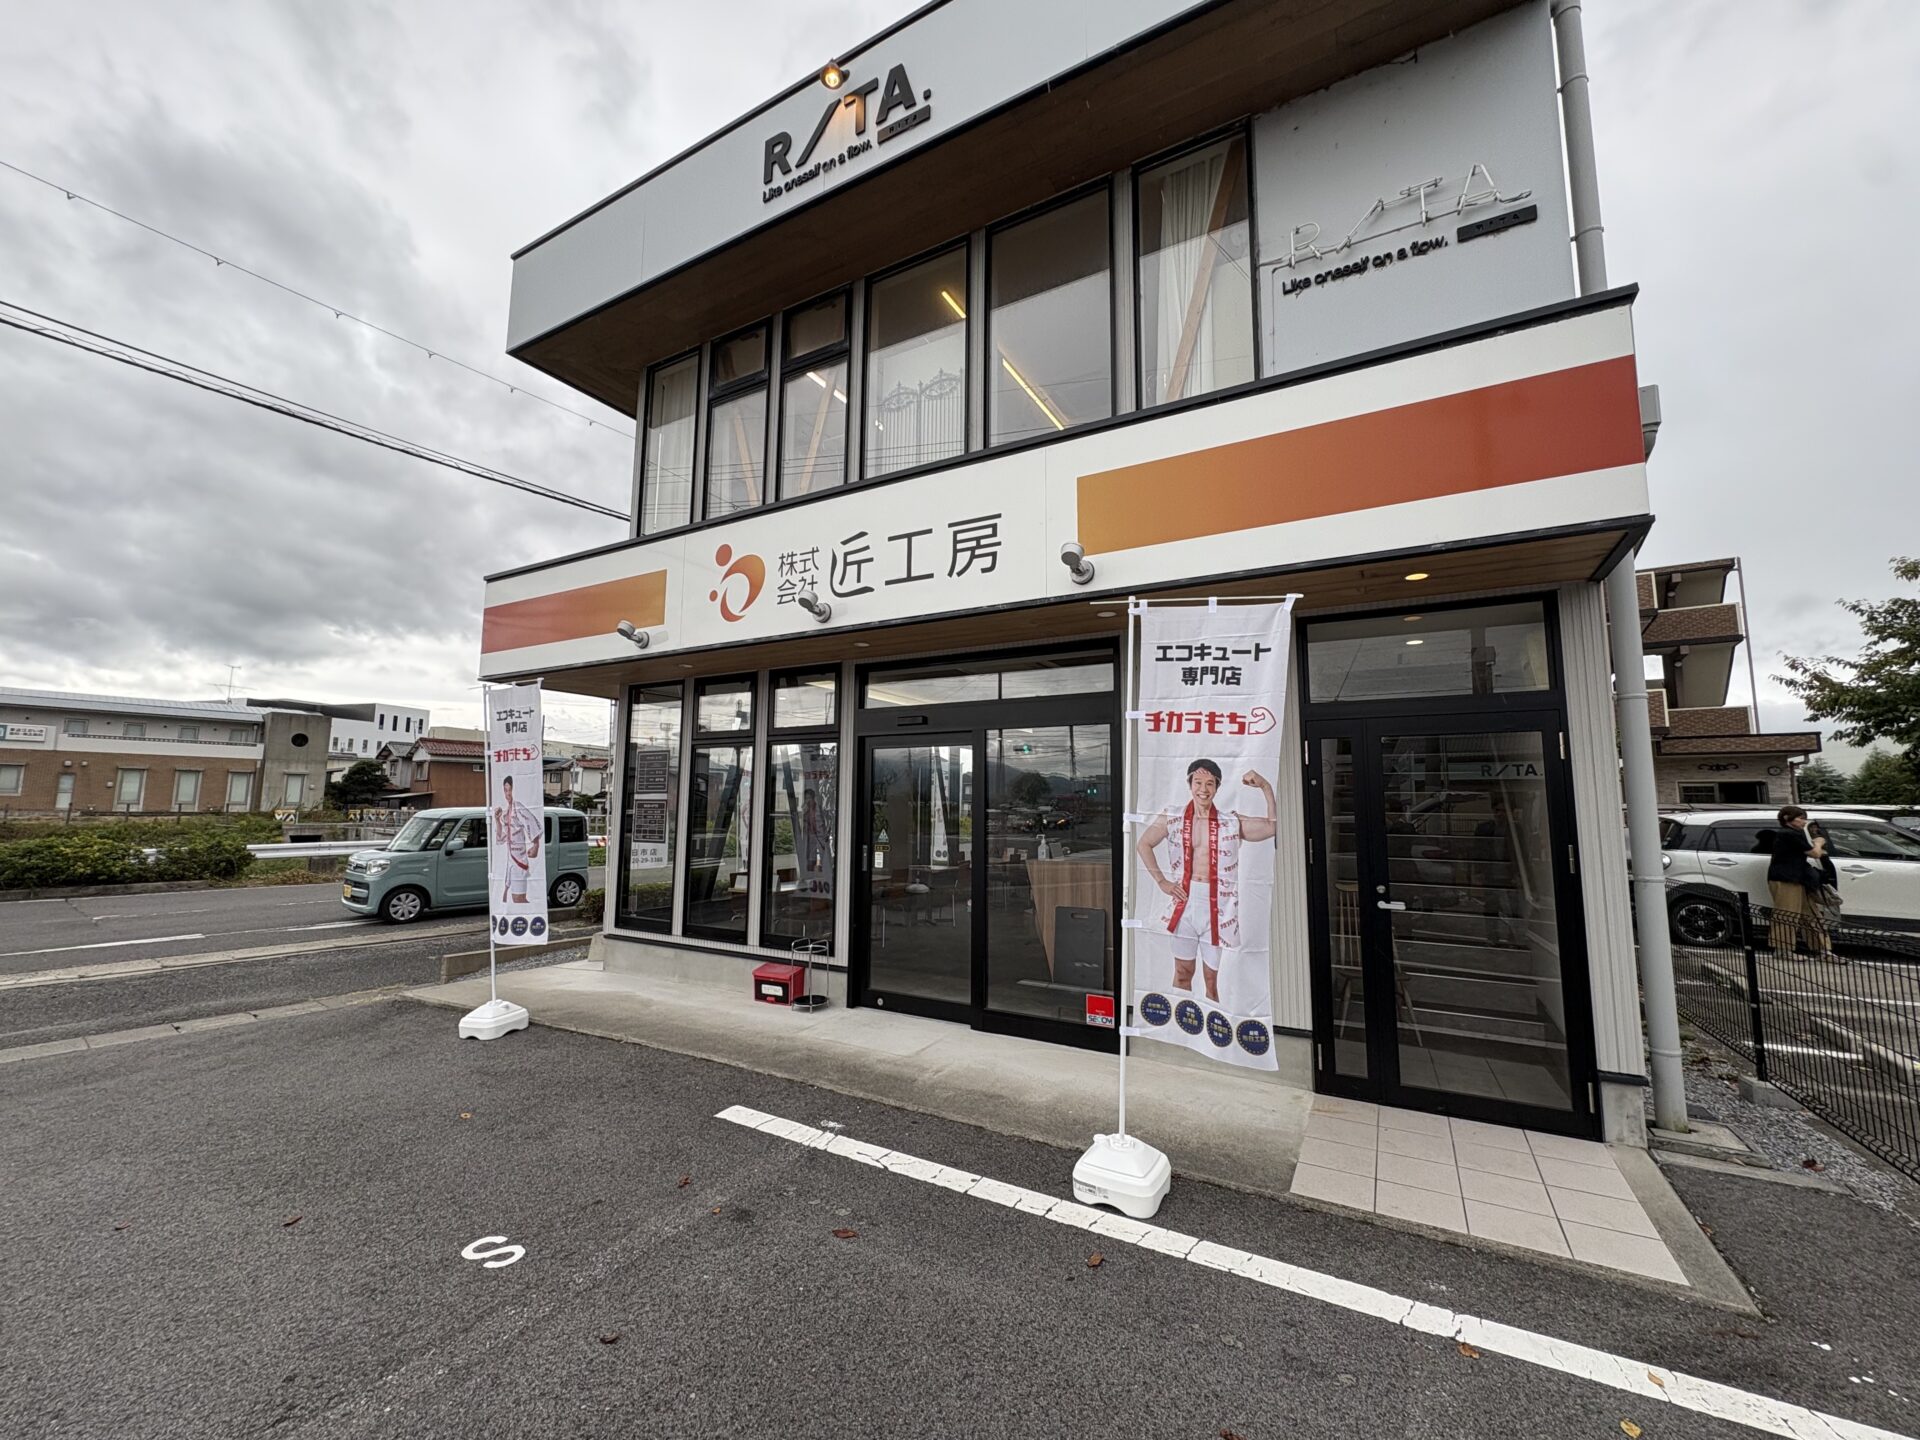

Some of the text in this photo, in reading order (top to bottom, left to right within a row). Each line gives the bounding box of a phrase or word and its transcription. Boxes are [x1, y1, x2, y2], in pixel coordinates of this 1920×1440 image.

[762, 182, 783, 204] Like
[784, 162, 821, 193] oneself
[822, 157, 836, 173] on
[837, 152, 846, 165] a
[1281, 276, 1313, 297] Like
[1313, 254, 1370, 285] oneself
[1371, 252, 1394, 270] on
[1396, 247, 1409, 263] a
[777, 546, 821, 578] 株式
[829, 512, 1003, 598] 匠工房
[1154, 642, 1272, 662] エコキュート
[1180, 665, 1243, 686] 専門店
[496, 705, 536, 722] エコキュート
[1145, 709, 1248, 736] チカラもち
[505, 721, 528, 734] 専門店
[1088, 1014, 1113, 1025] SECOM
